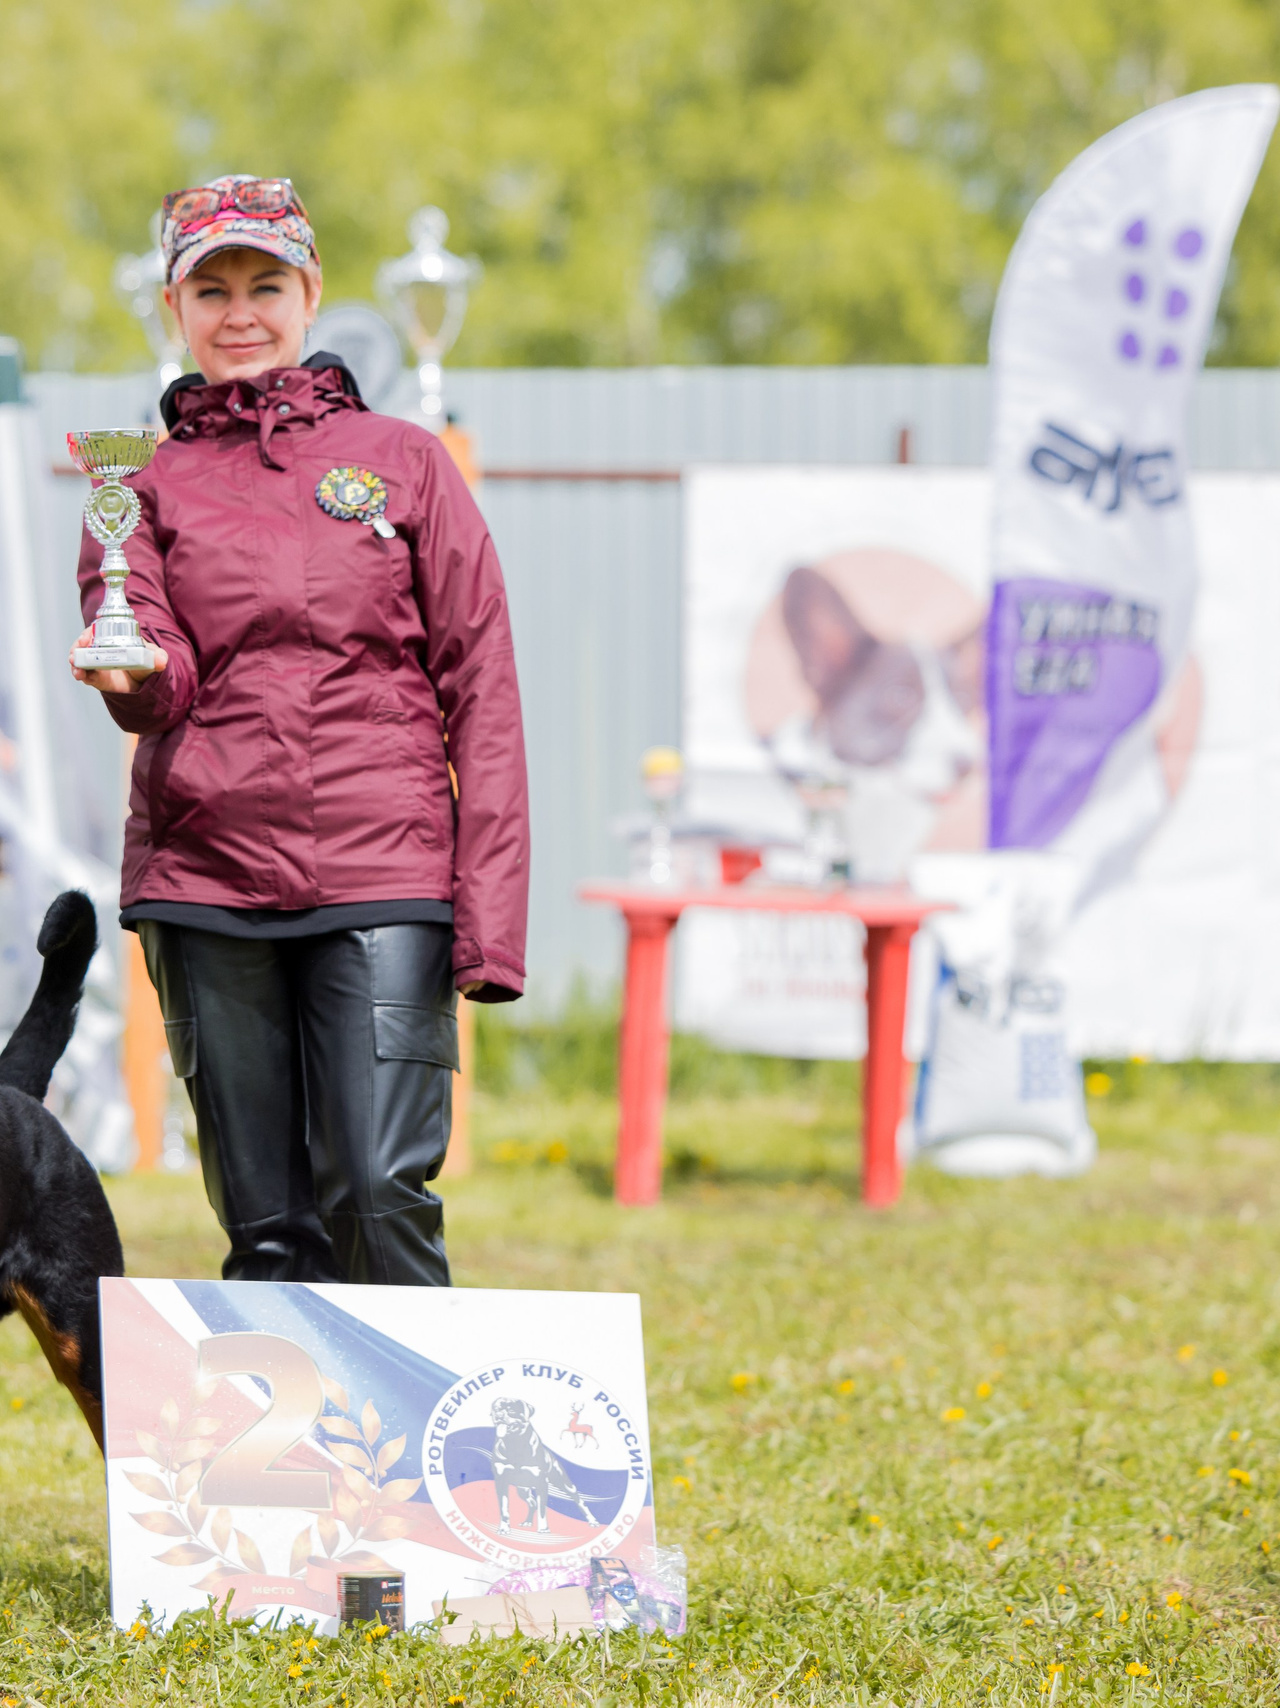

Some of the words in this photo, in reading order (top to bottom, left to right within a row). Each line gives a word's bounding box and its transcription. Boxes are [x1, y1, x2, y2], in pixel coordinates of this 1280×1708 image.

[198, 1331, 333, 1509] 2
[428, 1367, 505, 1476] РОТВЕЙЛЕР
[522, 1364, 584, 1389] КЛУБ
[593, 1391, 645, 1480] РОССИИ
[615, 1513, 635, 1537] РО
